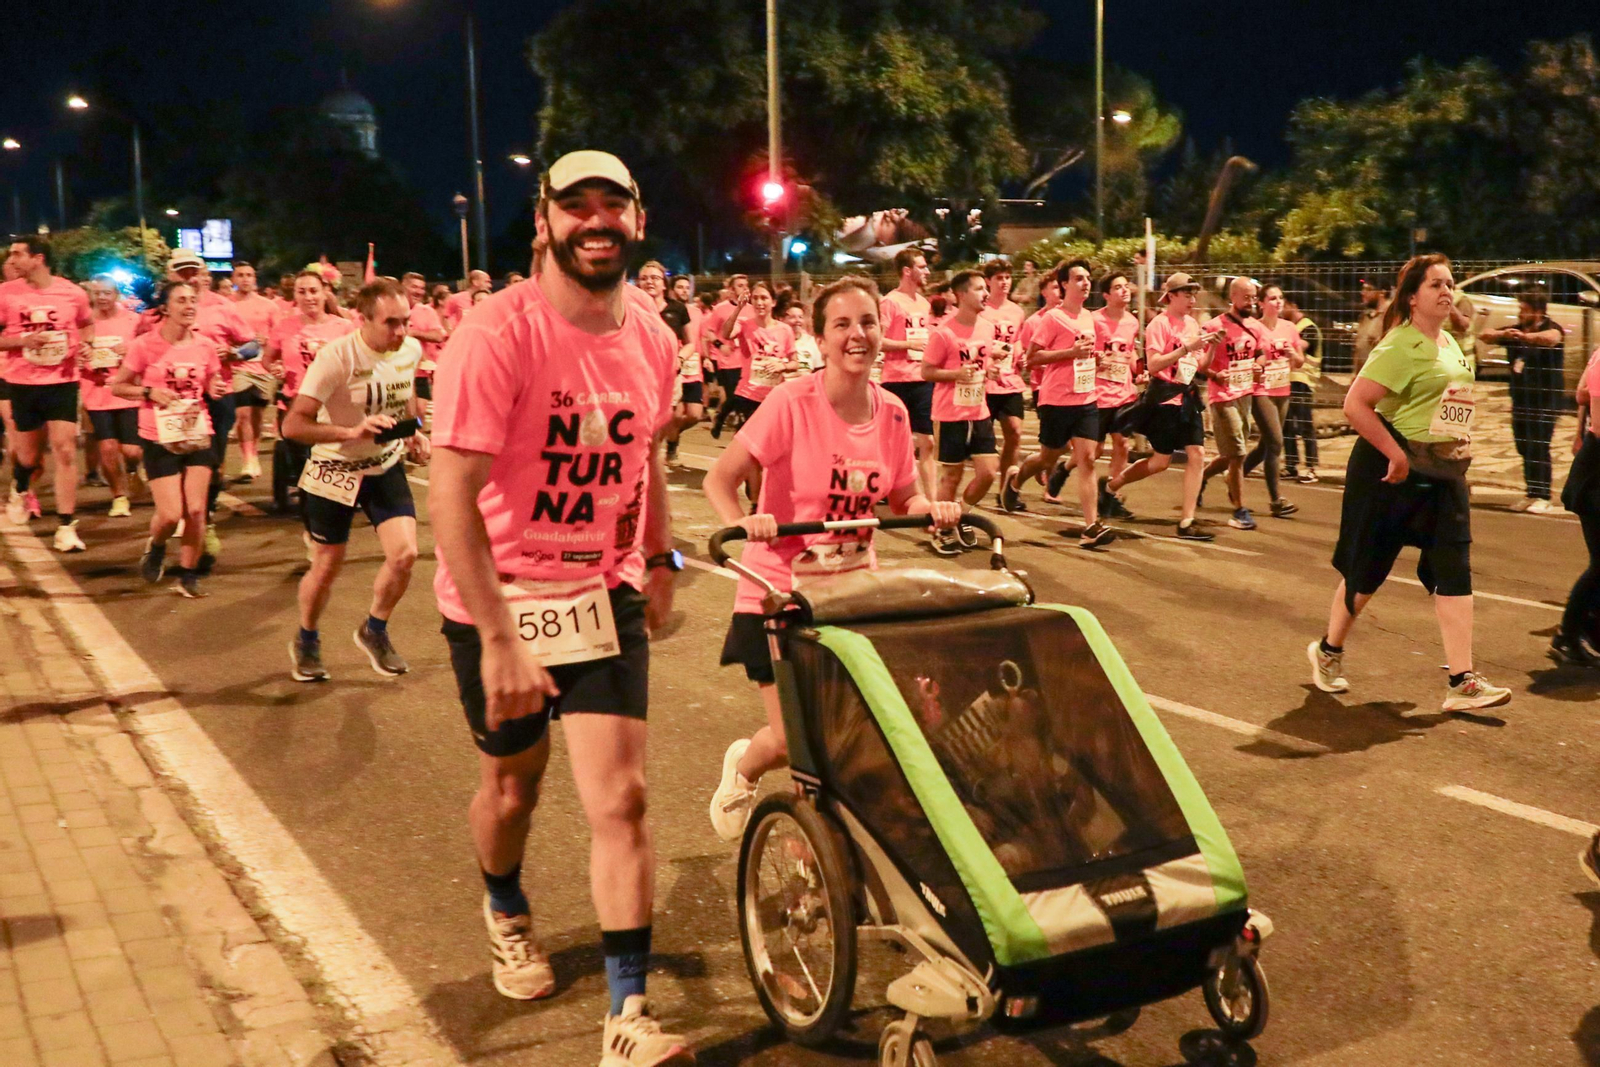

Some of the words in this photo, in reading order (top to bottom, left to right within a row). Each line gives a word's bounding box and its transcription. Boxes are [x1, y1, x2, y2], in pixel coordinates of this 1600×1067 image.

[551, 390, 574, 408] 36
[1440, 404, 1473, 424] 3087
[541, 450, 623, 488] TUR
[530, 489, 595, 525] NA
[827, 493, 872, 516] TUR
[518, 601, 601, 642] 5811
